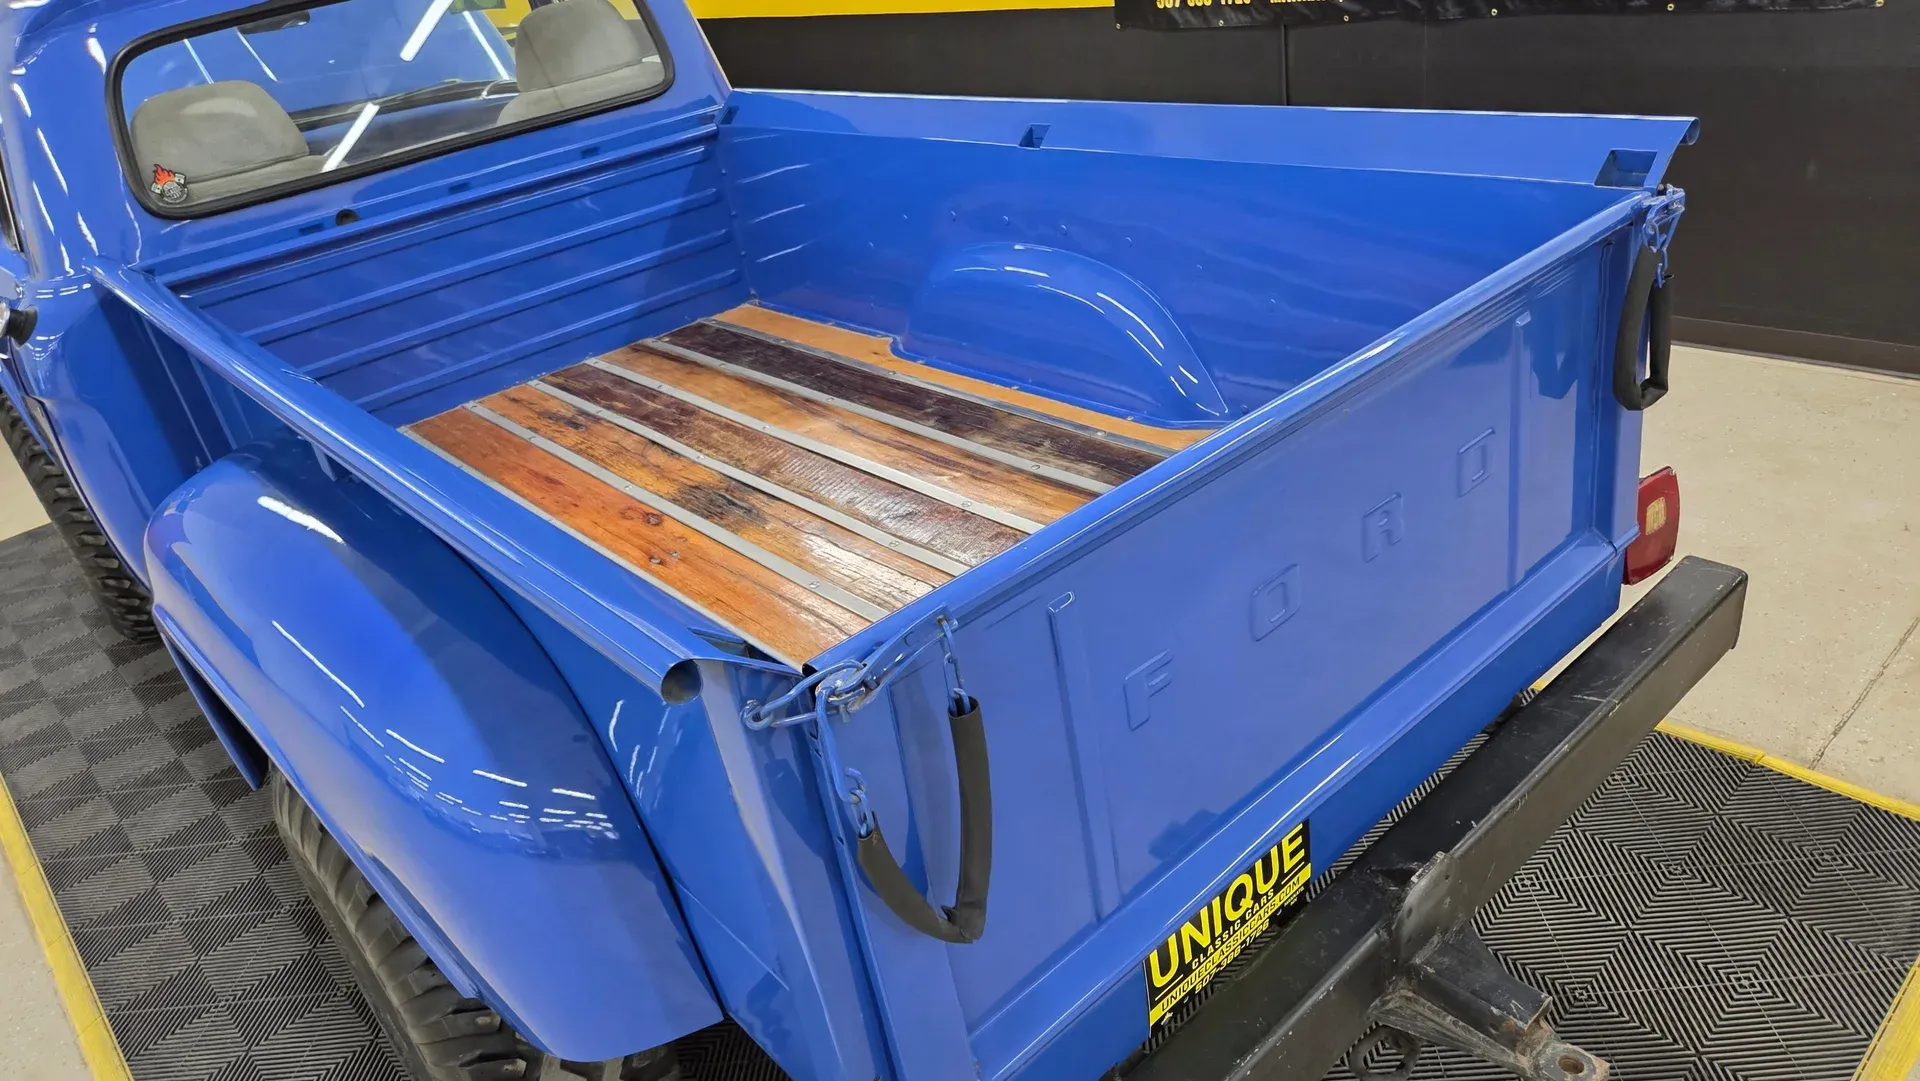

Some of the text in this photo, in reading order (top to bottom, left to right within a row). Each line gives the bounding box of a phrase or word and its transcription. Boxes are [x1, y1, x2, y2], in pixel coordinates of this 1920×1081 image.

[1123, 427, 1496, 731] FORD
[1149, 823, 1305, 988] UNIQUE
[1161, 875, 1300, 1012] UNIQUECLASSICCARS.COM
[1192, 919, 1241, 969] CLASSIC
[1246, 888, 1274, 920] CARS
